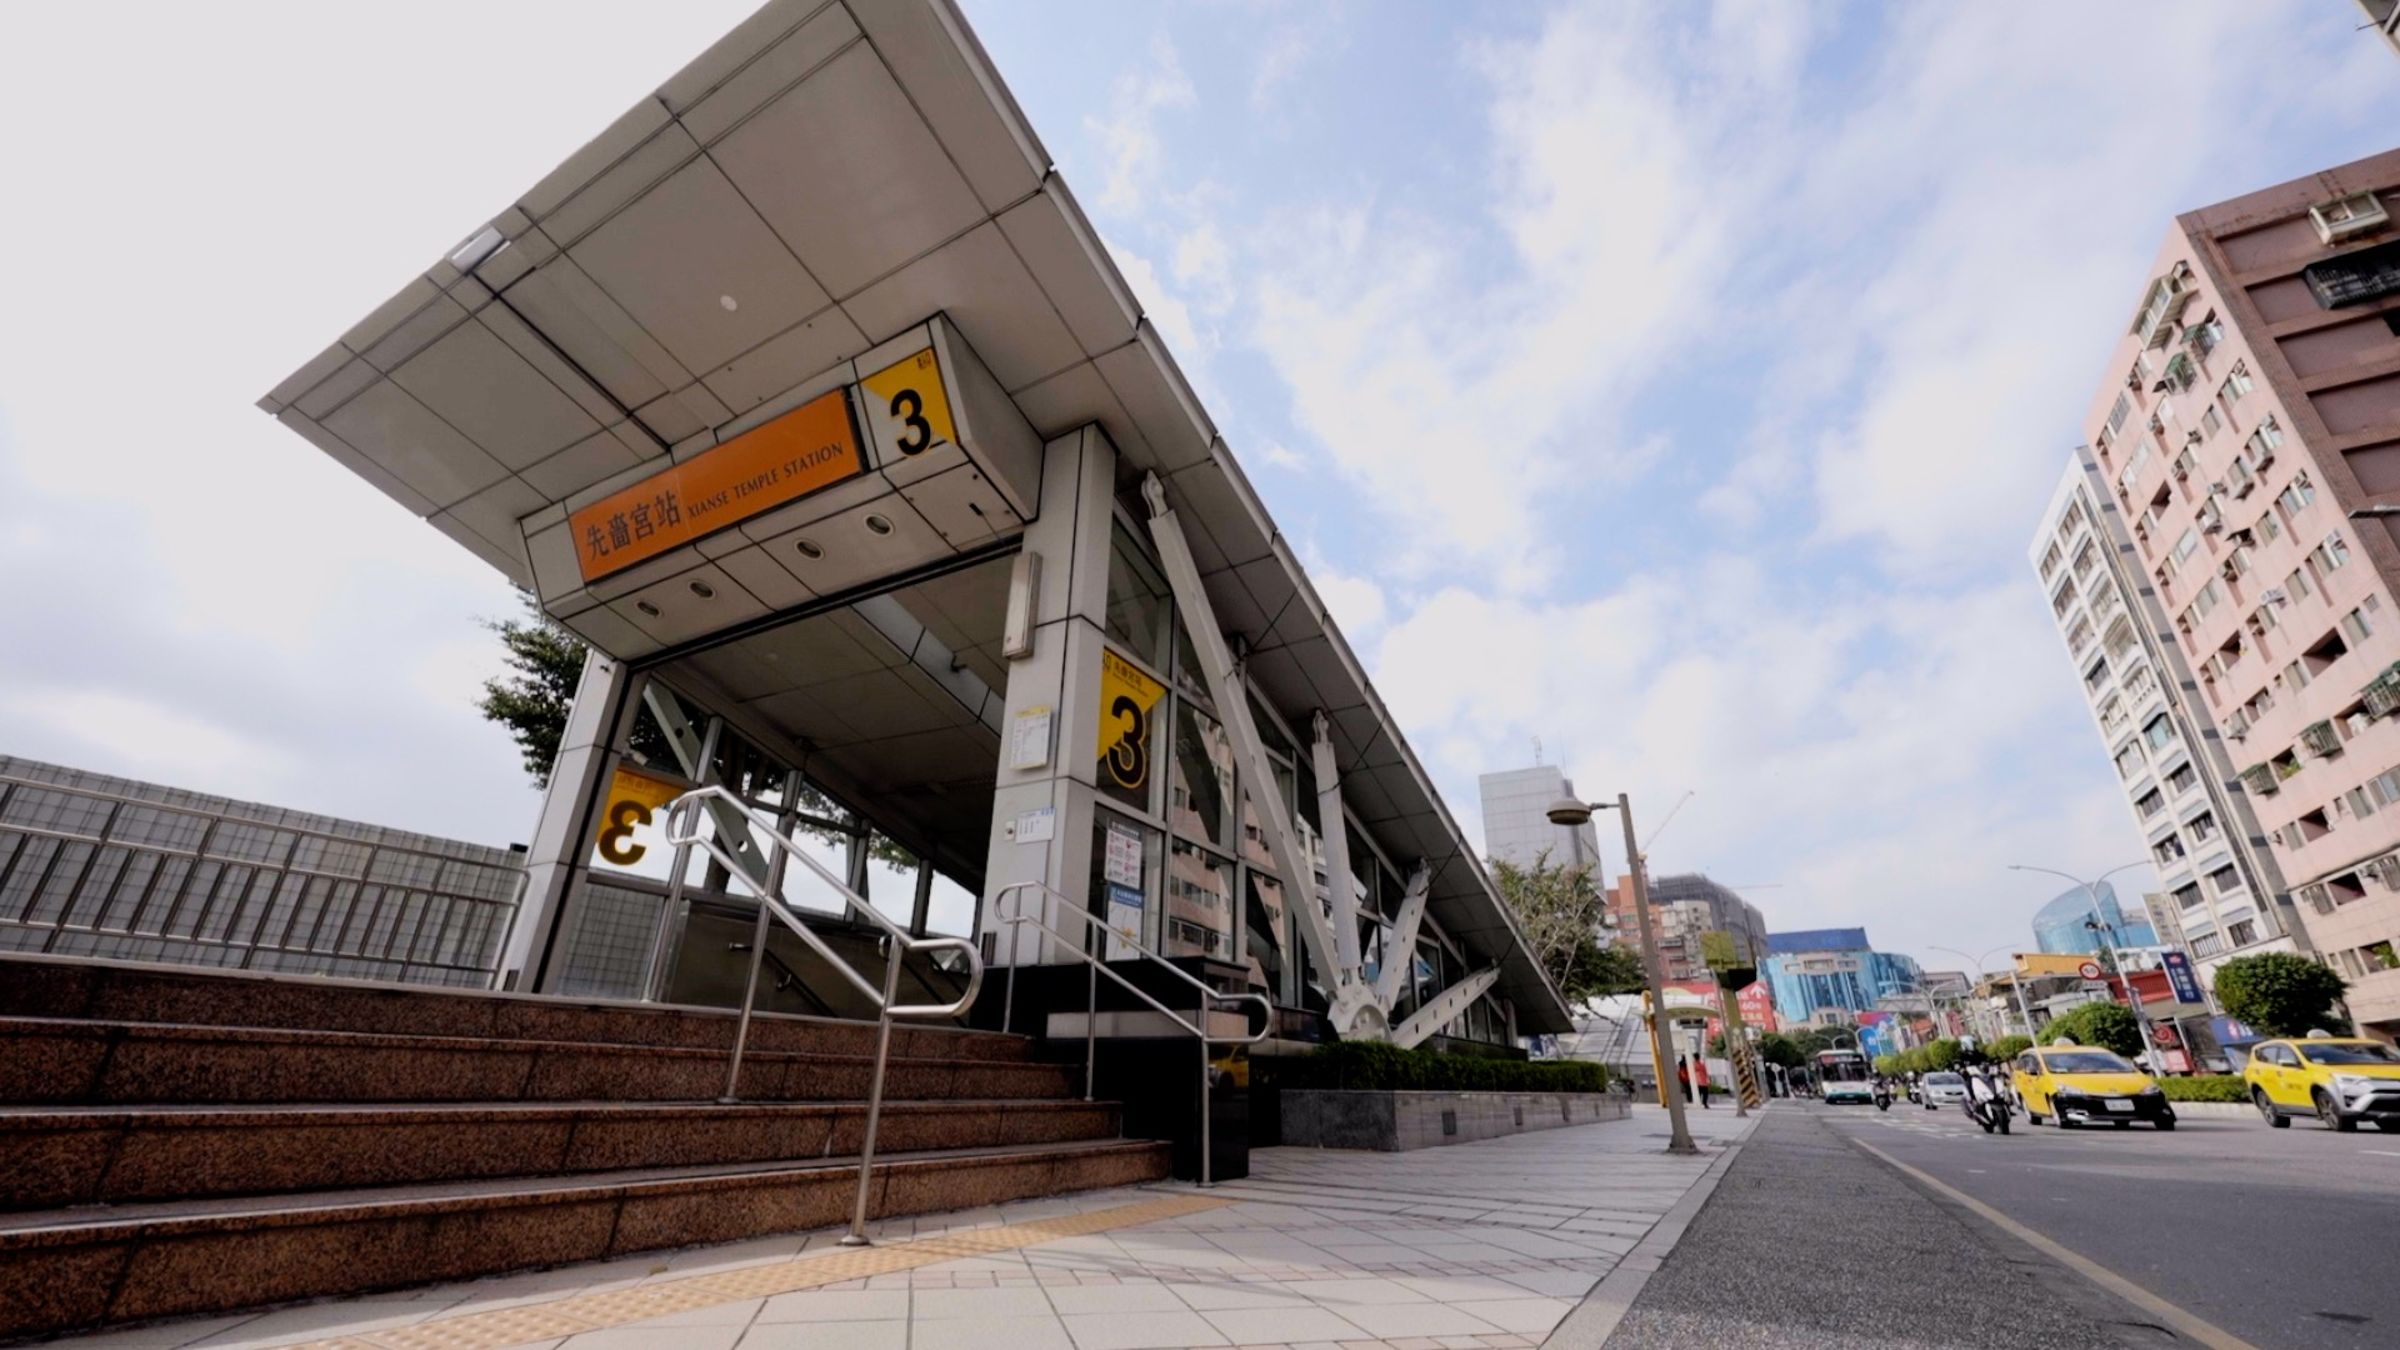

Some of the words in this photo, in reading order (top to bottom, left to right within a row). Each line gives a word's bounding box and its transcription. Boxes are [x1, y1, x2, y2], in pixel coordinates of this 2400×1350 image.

[890, 389, 931, 456] 3
[687, 490, 729, 519] XIANSE
[734, 468, 778, 499] TEMPLE
[784, 442, 843, 478] STATION
[587, 490, 680, 560] 先嗇宮站
[1107, 695, 1146, 788] 3
